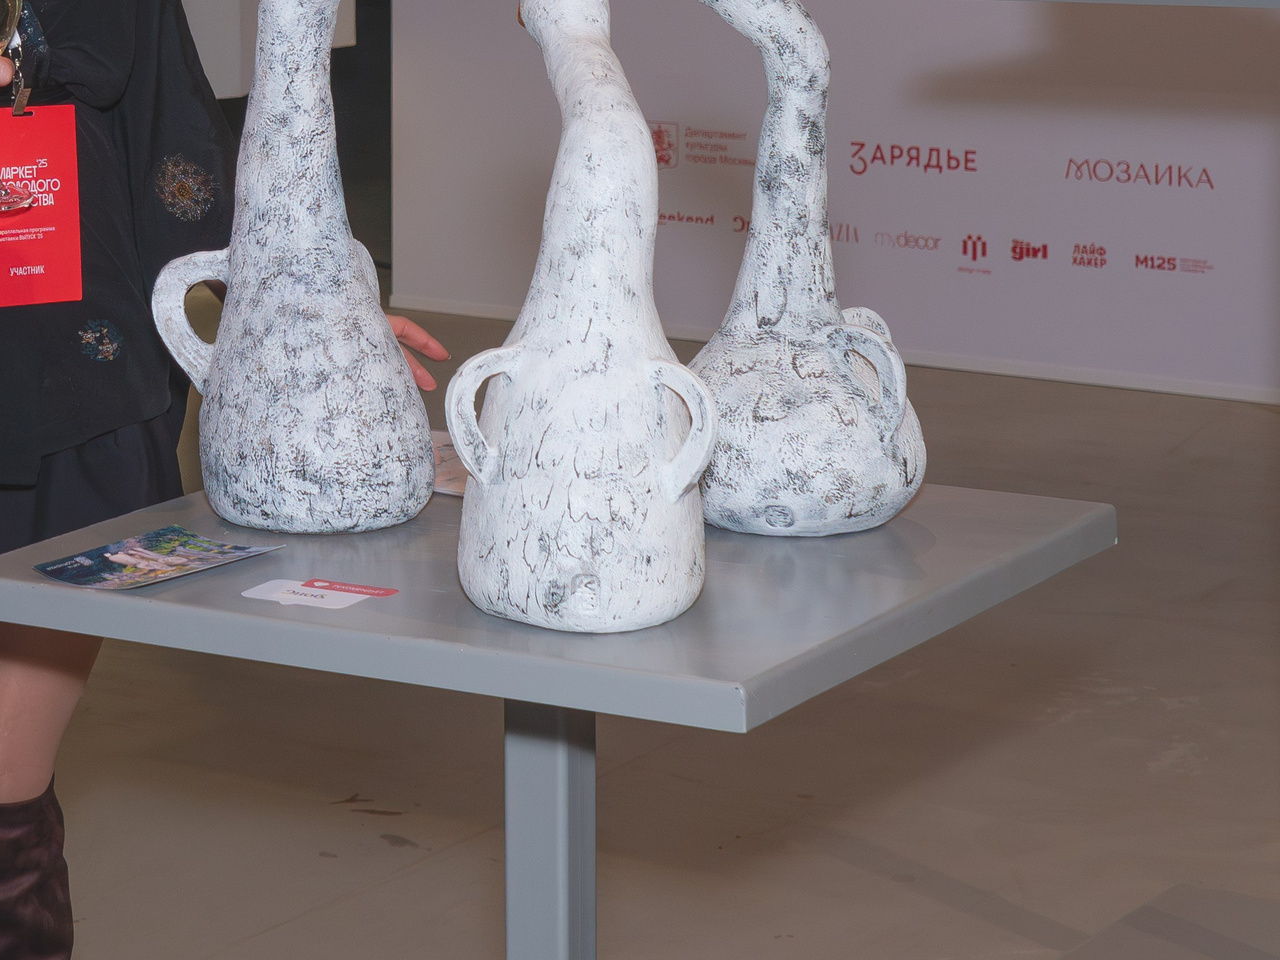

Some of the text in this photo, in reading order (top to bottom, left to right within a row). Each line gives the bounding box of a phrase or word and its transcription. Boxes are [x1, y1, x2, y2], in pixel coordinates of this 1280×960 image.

[850, 141, 977, 175] ЗАРЯДЬЕ
[1065, 158, 1215, 190] МОЗАИКА
[1011, 241, 1049, 261] girl
[1072, 243, 1107, 257] ЛАЙФ
[9, 265, 46, 277] УЧАСТНИК
[1072, 256, 1107, 269] ХАКЕР
[1135, 254, 1177, 271] M125
